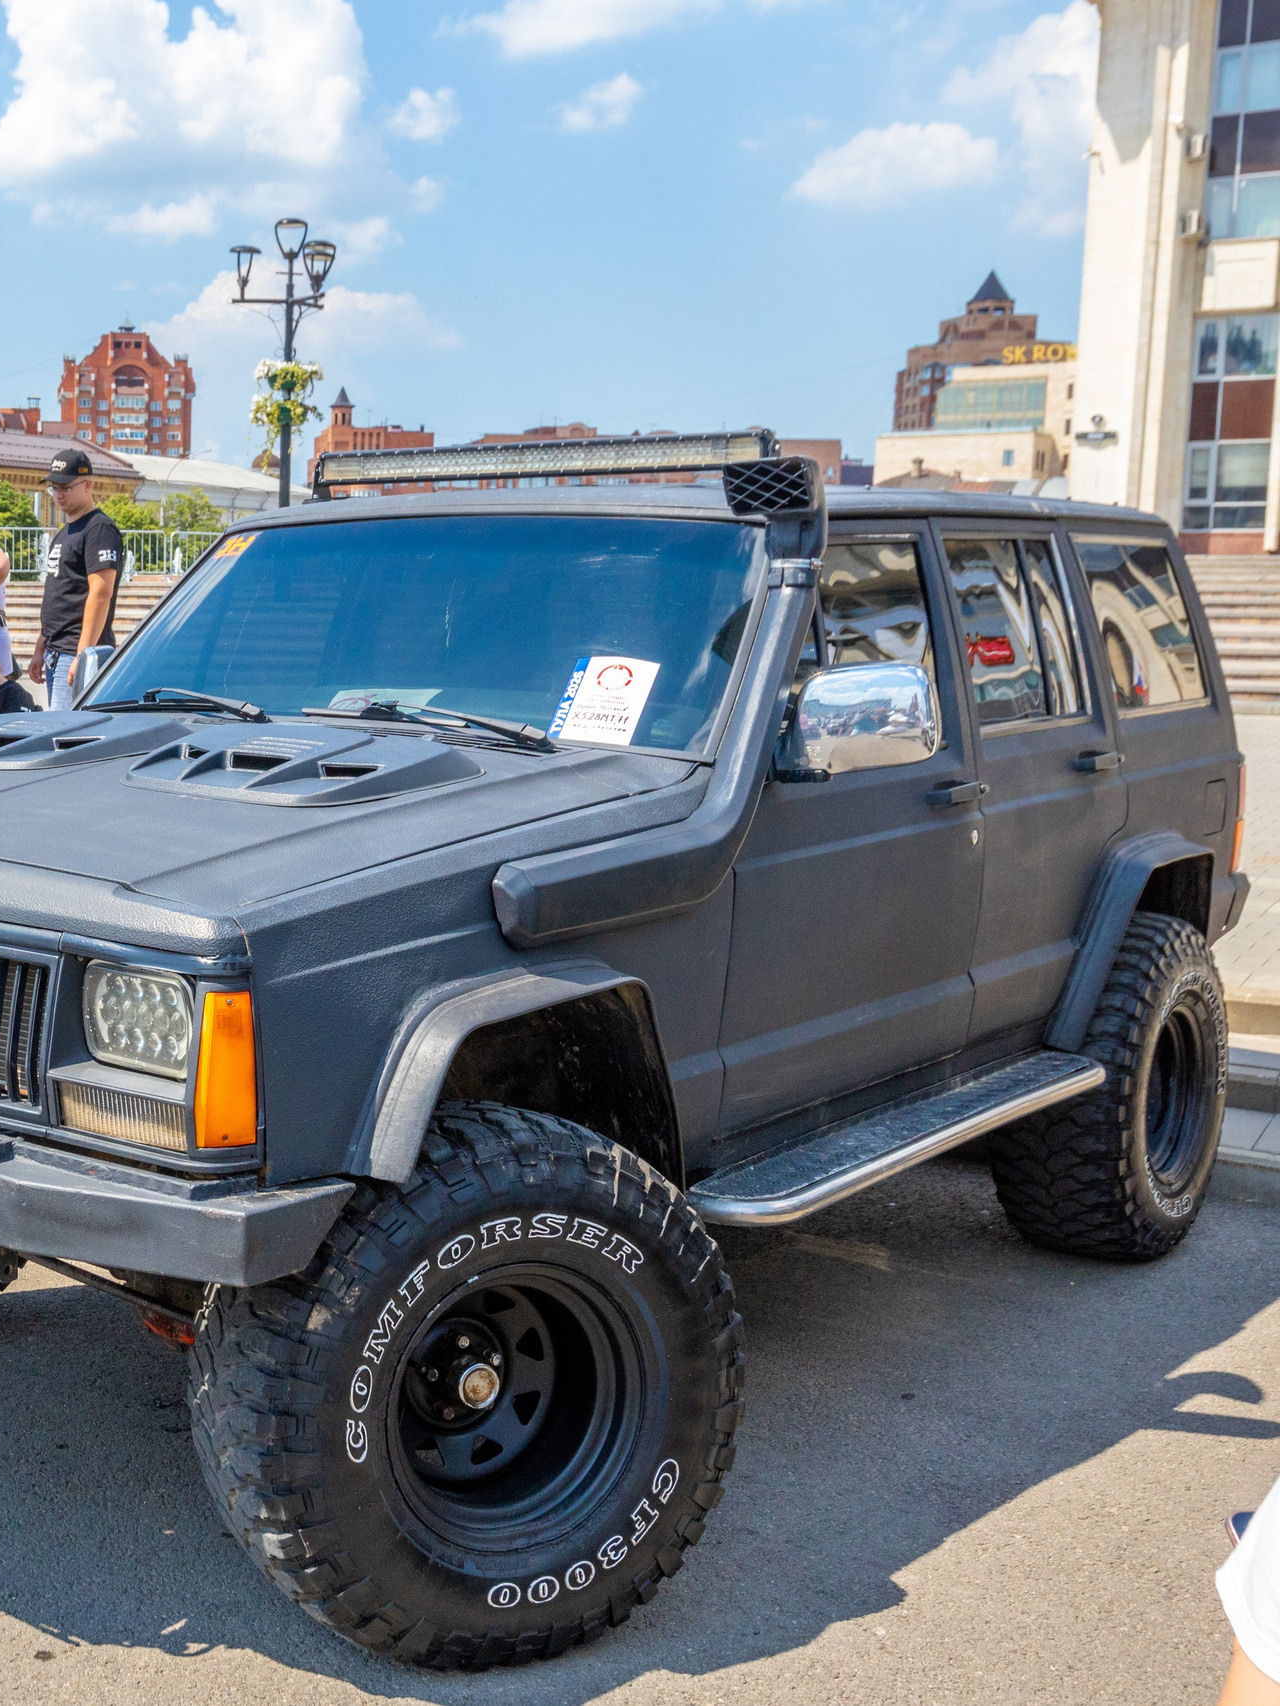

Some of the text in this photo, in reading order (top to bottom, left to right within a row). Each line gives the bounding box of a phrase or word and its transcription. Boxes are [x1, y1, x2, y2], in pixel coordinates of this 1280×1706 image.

[1002, 345, 1026, 364] SK
[549, 700, 573, 734] ТУЛА
[346, 1212, 645, 1463] COMFORSER
[487, 1458, 680, 1608] CF3000
